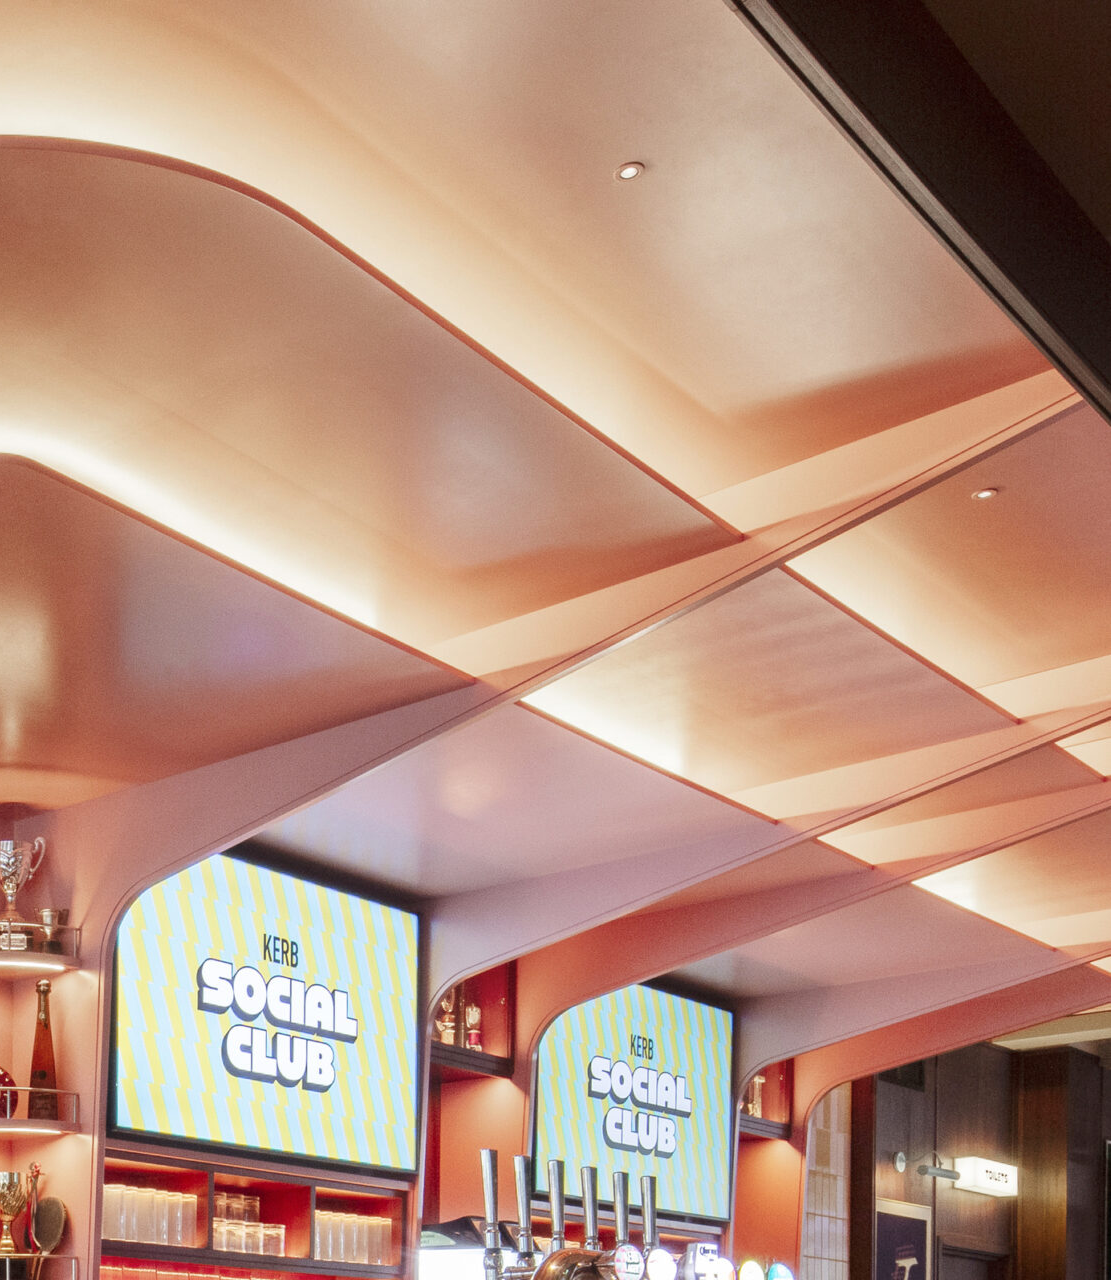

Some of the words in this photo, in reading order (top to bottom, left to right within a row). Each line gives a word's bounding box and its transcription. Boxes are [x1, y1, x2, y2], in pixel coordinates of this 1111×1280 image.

[263, 933, 299, 968] KERB
[196, 957, 358, 1044] SOCIAL
[221, 1023, 336, 1093] CLUB
[630, 1033, 654, 1060] KERB
[587, 1055, 693, 1119] SOCIAL
[602, 1106, 677, 1159] CLUB
